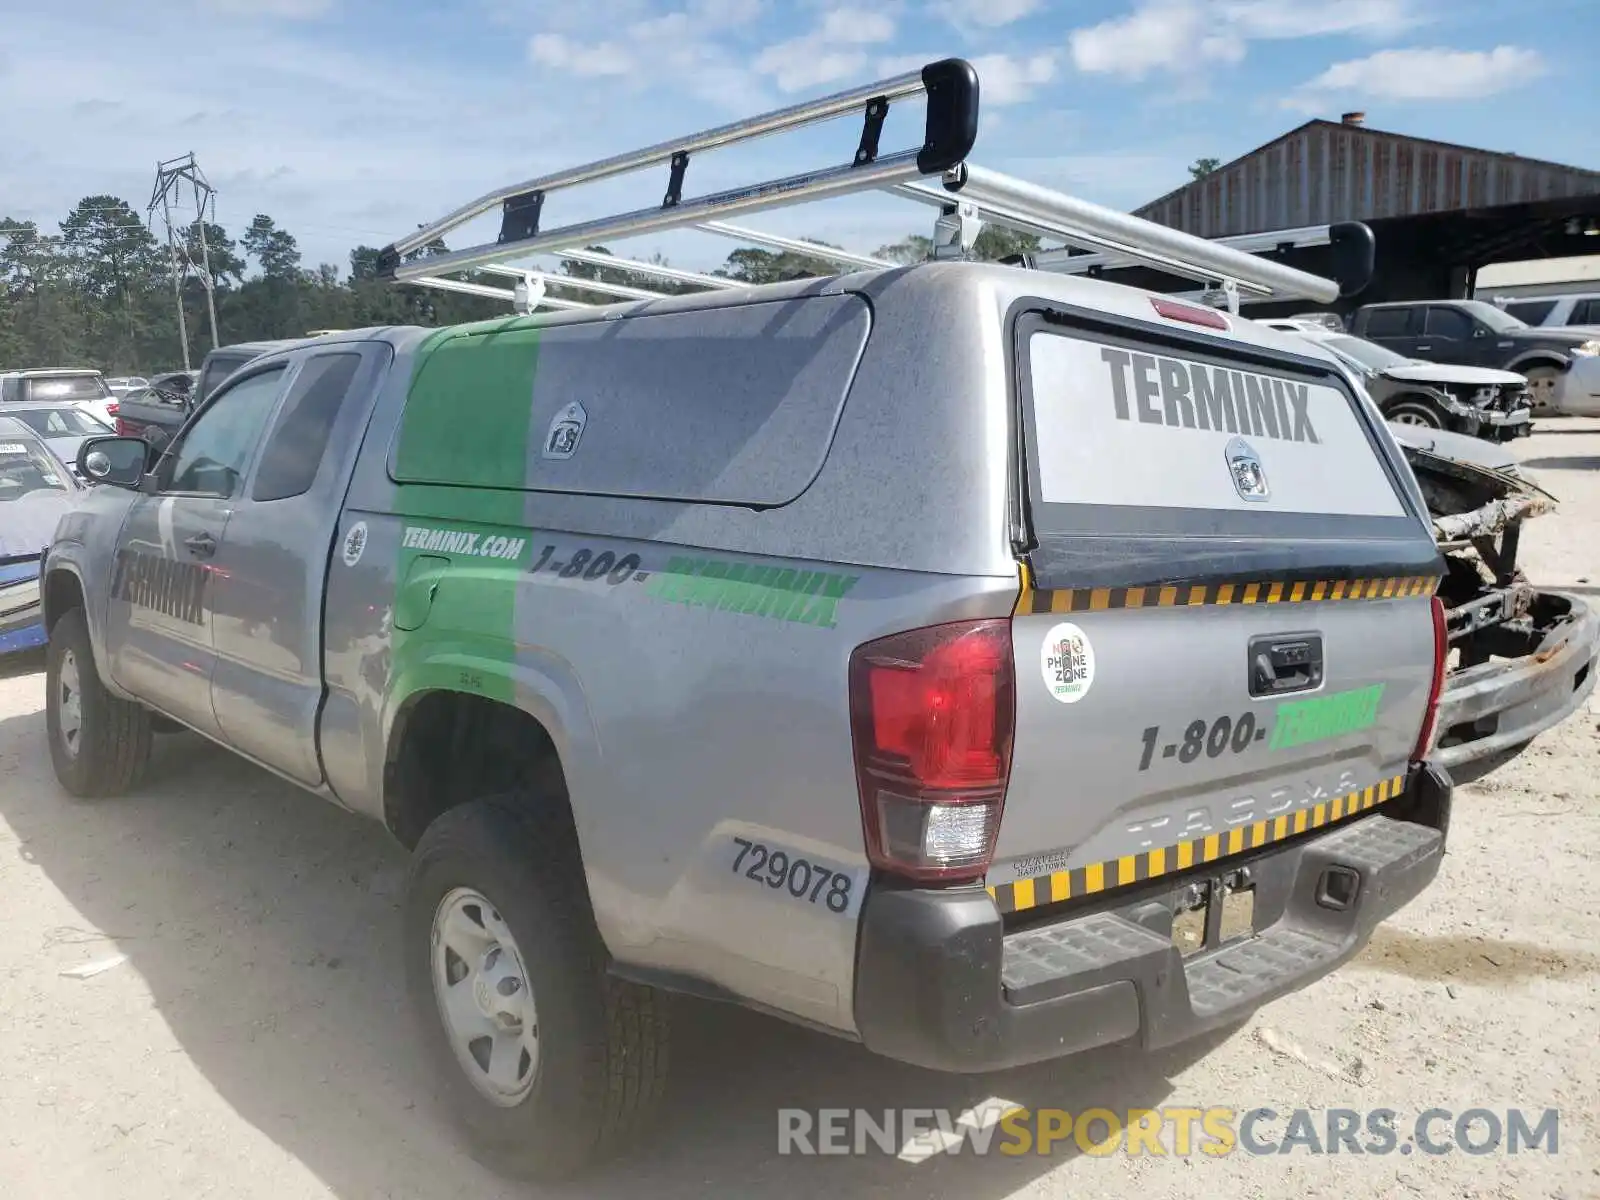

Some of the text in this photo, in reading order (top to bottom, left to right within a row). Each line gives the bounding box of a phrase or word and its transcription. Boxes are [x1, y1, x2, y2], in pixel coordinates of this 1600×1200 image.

[1100, 347, 1322, 444] TERMINIX
[402, 527, 526, 560] TERMINIX.COM
[1055, 668, 1088, 682] ZONE
[731, 837, 852, 913] 729078
